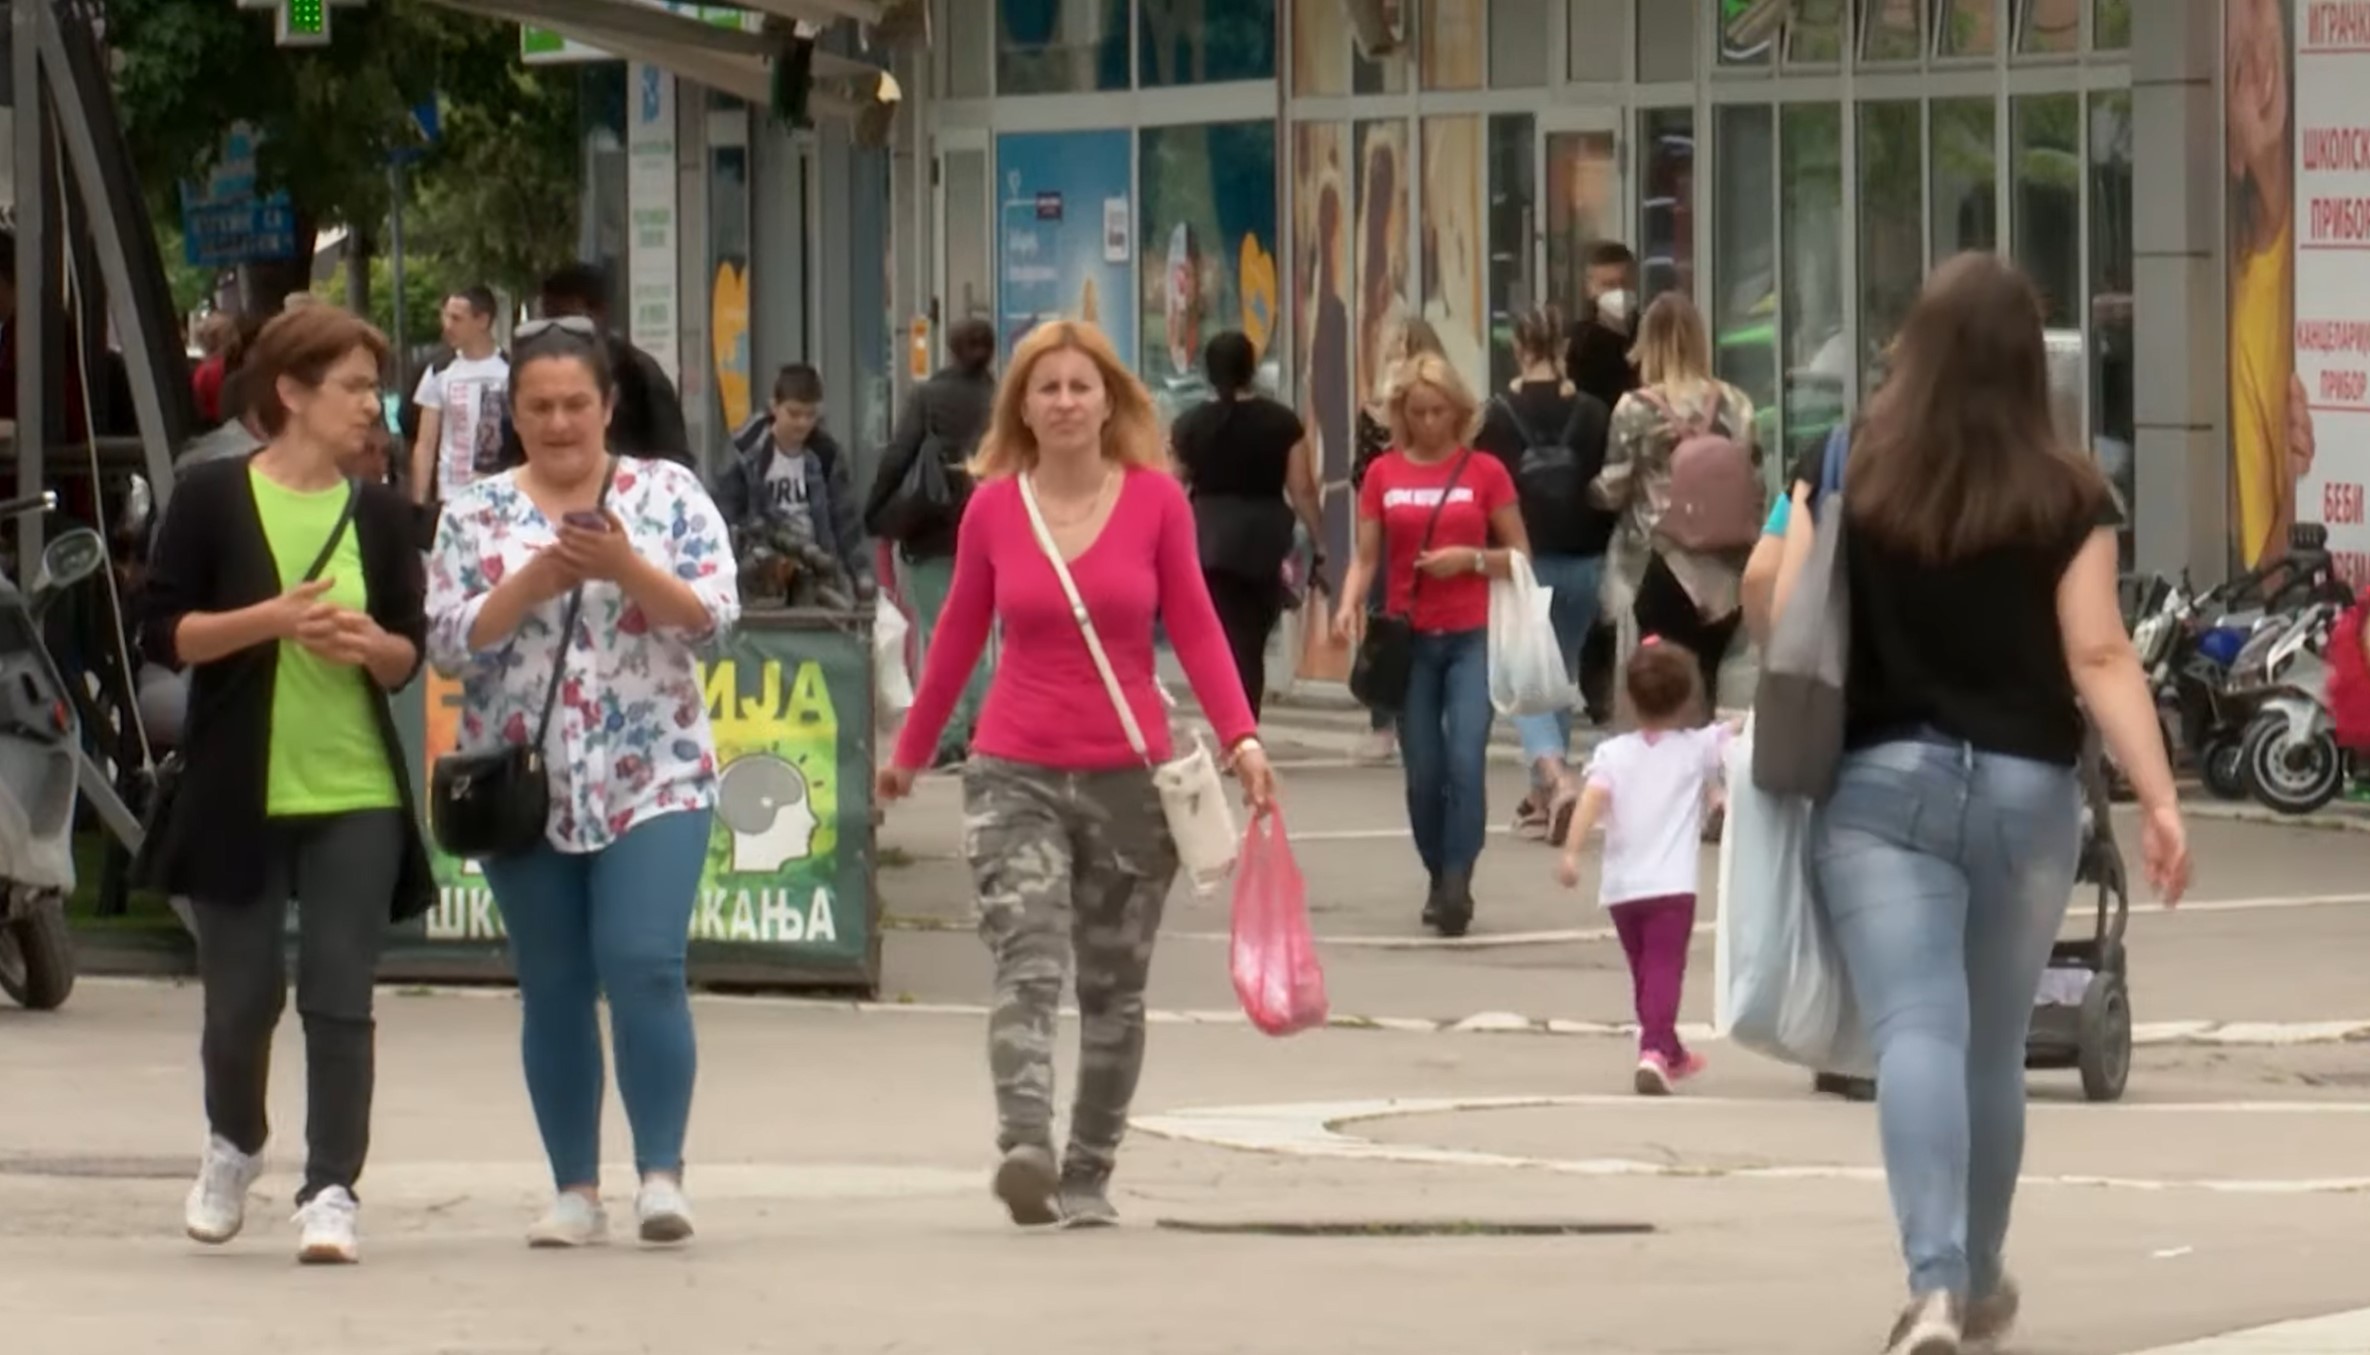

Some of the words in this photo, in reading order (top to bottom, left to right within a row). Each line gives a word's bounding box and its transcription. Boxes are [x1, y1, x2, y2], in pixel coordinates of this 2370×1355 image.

[2320, 369, 2366, 399] ПРИБОР
[2324, 482, 2363, 523] БЕБИ
[427, 887, 508, 939] ШК
[690, 887, 836, 940] КАЊА
